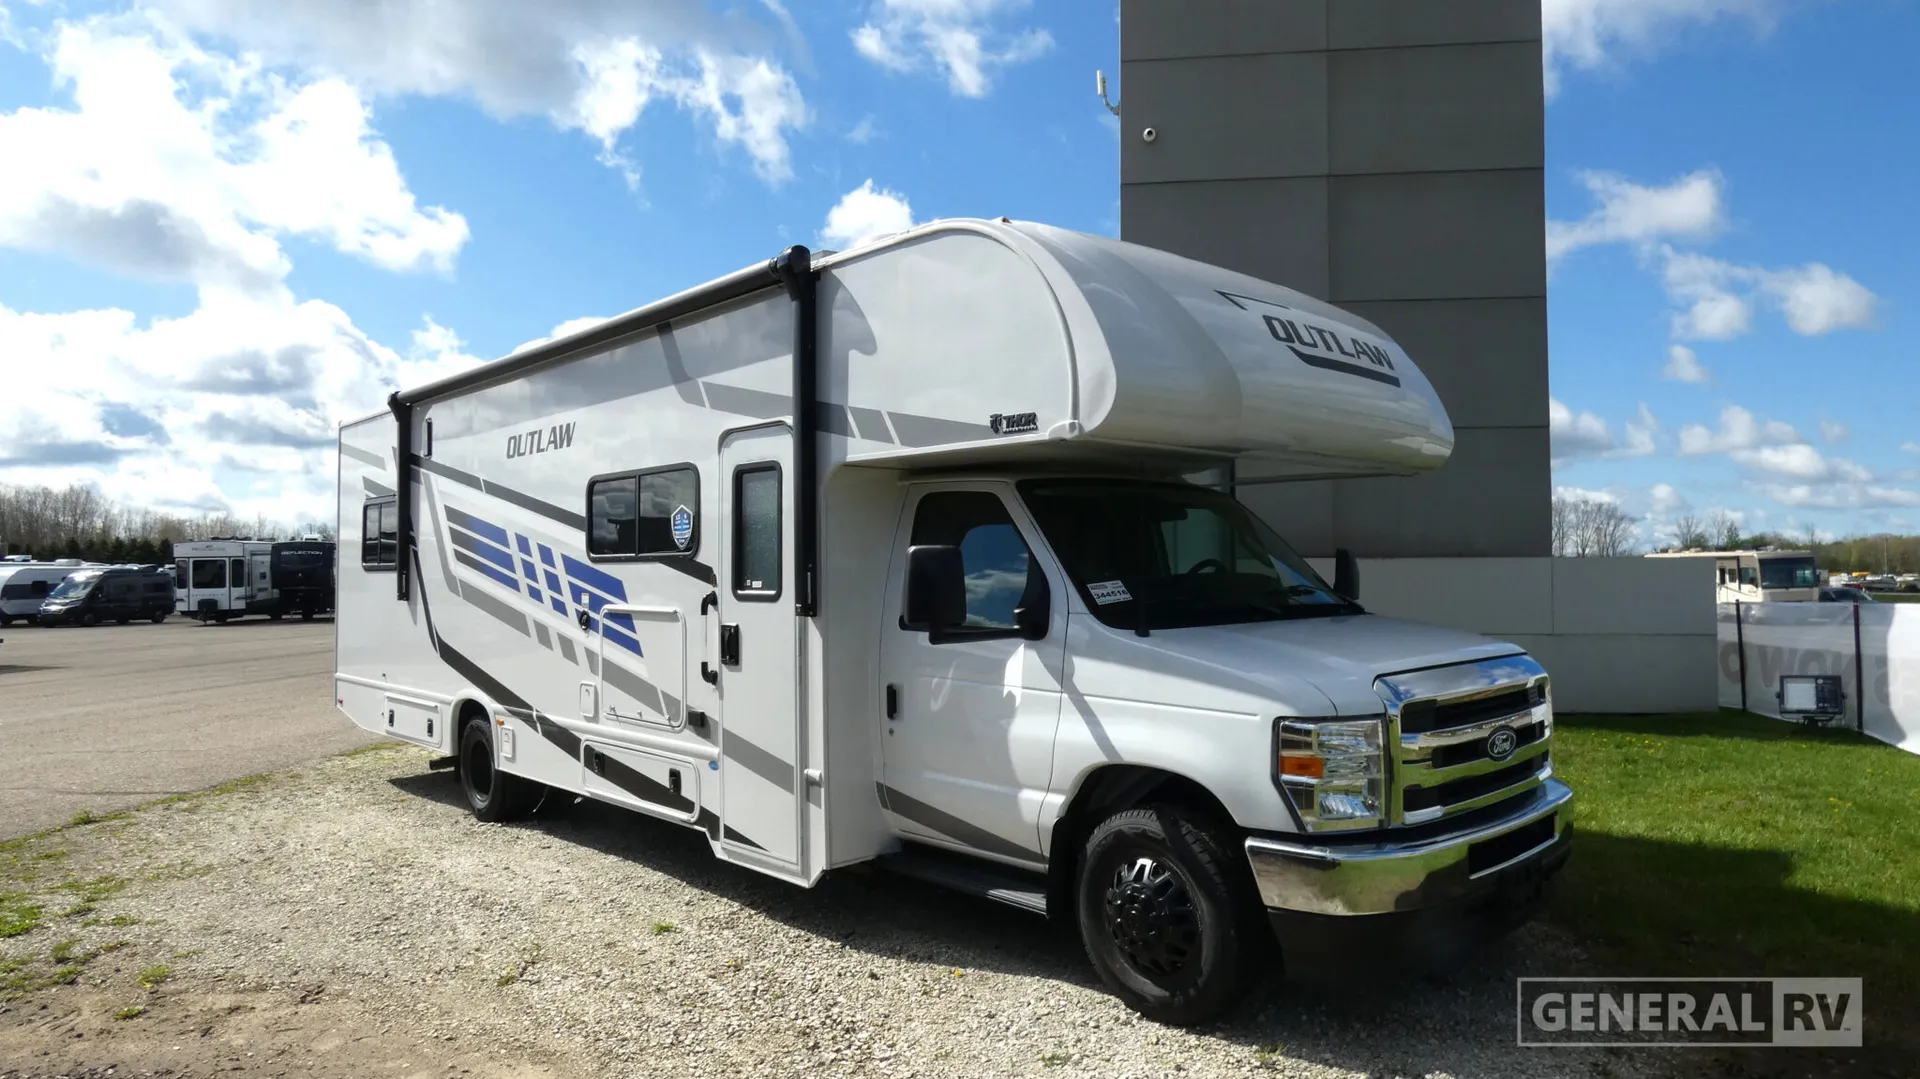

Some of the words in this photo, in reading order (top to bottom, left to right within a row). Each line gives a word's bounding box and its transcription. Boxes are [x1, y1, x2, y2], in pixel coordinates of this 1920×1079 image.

[1262, 314, 1395, 370] OUTLAW
[1003, 412, 1037, 428] THOR
[506, 421, 576, 459] OUTLAW
[1493, 735, 1511, 753] Ford
